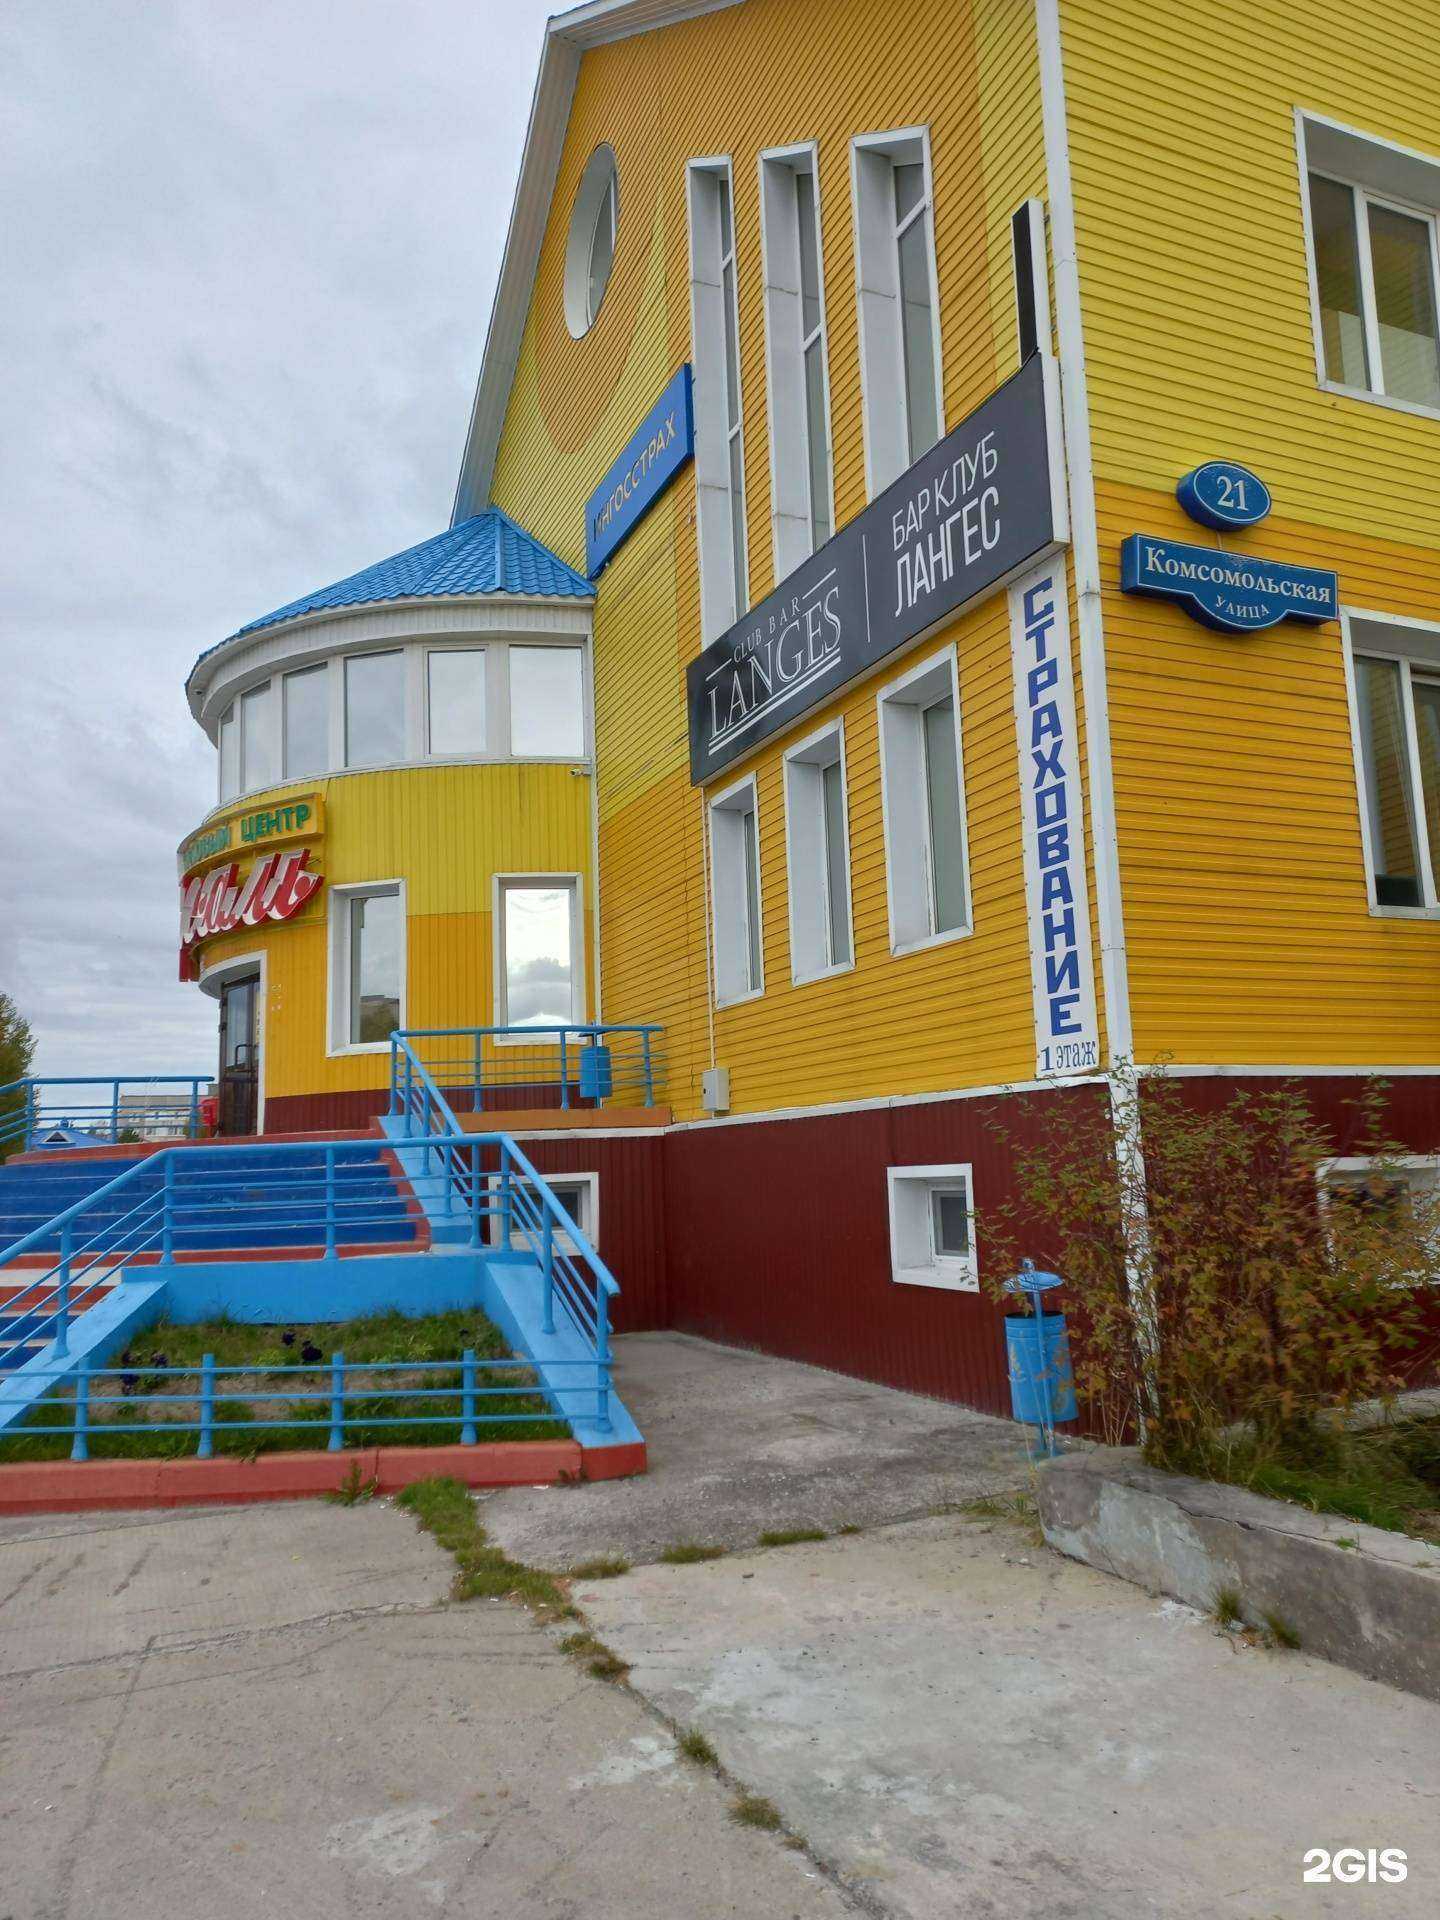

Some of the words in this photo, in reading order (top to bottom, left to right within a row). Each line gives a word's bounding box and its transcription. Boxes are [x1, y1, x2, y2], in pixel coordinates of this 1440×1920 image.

[593, 411, 677, 541] ИНГОССТРАХ
[892, 487, 930, 551] БАР
[934, 430, 999, 516] КЛУБ
[1216, 475, 1249, 511] 21
[894, 486, 1001, 617] ЛАНГЕС
[1145, 546, 1331, 603] Комсомольская
[707, 586, 842, 741] LANGES
[733, 627, 762, 663] CLUB
[768, 596, 801, 634] BAR
[240, 803, 312, 843] ЦЕНТР
[1023, 576, 1082, 1036] СТРАХОВАНИЕ
[1040, 1046, 1054, 1071] 1
[1056, 1040, 1096, 1069] этаж
